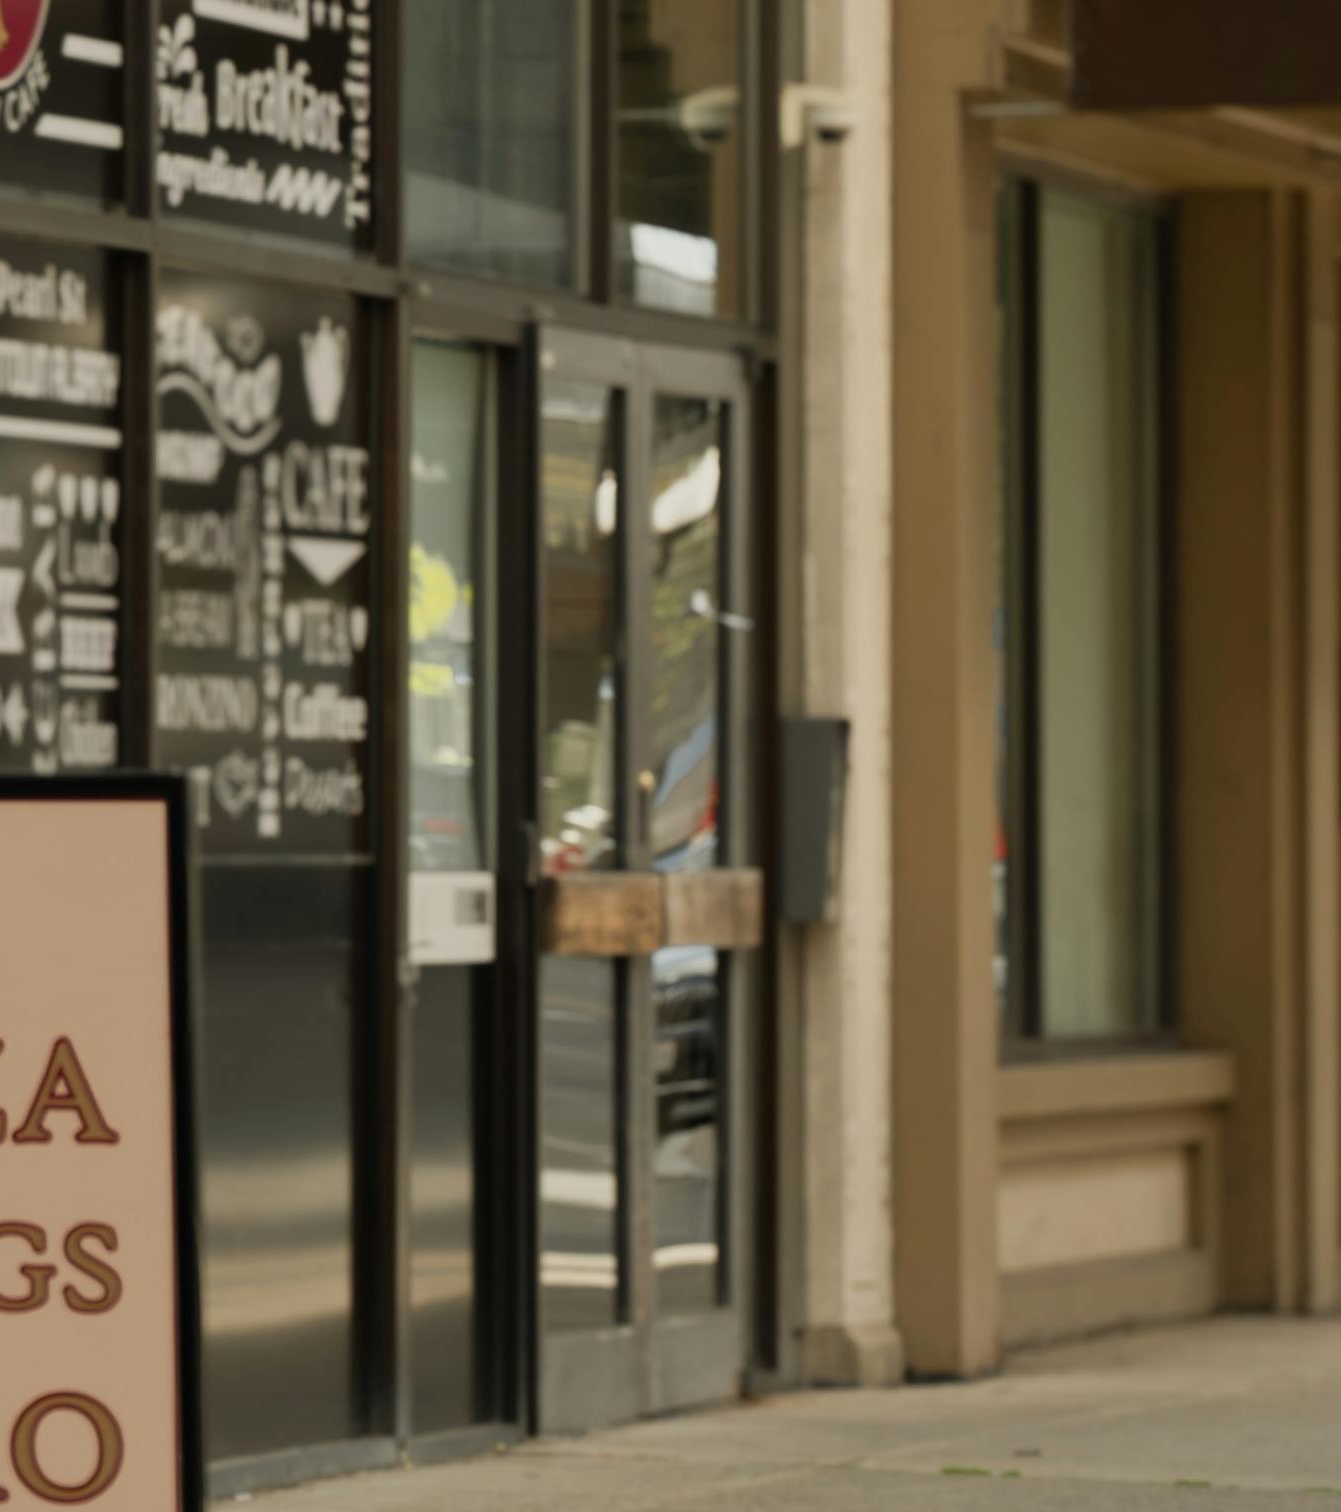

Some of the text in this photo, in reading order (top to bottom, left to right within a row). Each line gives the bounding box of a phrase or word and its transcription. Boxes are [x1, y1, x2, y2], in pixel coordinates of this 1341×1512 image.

[216, 42, 346, 155] Breakfast
[59, 269, 88, 325] St
[282, 439, 371, 536] CAFE
[300, 597, 355, 667] TEA
[282, 681, 368, 742] Coffee
